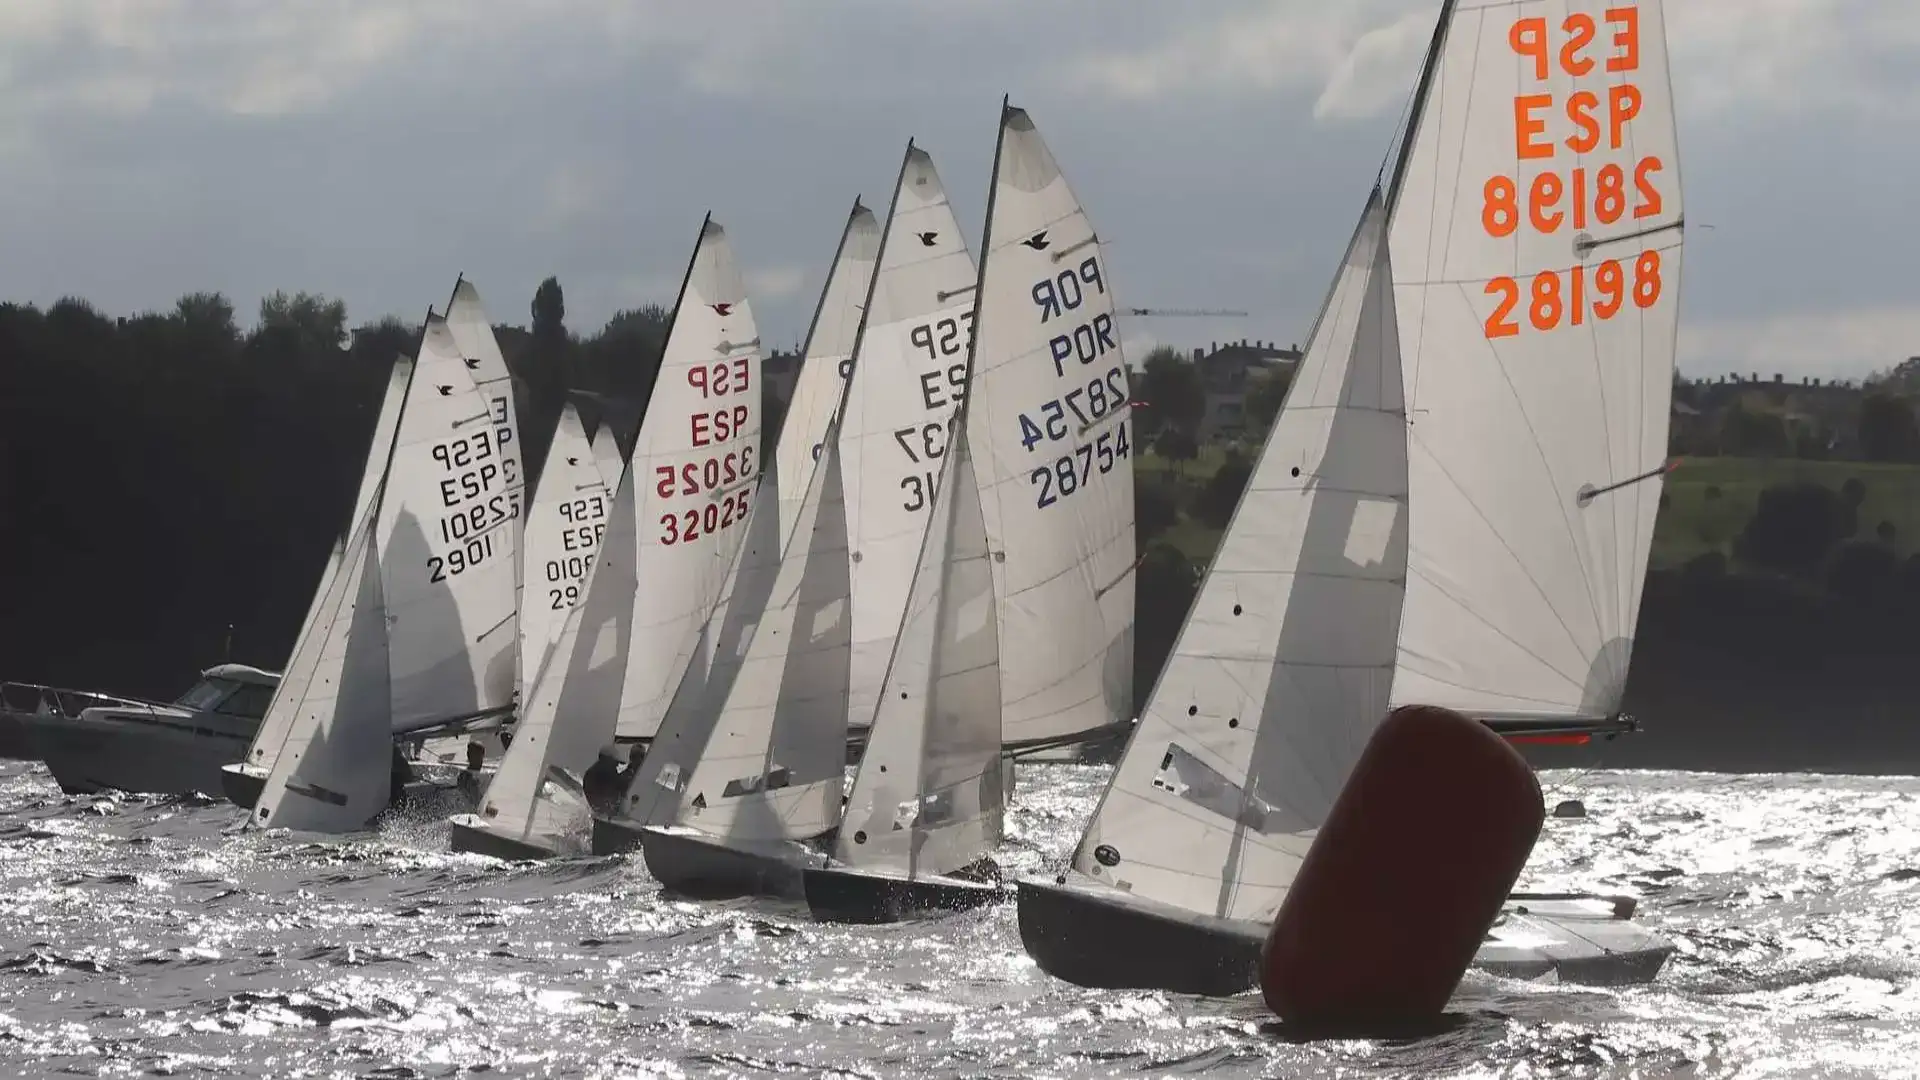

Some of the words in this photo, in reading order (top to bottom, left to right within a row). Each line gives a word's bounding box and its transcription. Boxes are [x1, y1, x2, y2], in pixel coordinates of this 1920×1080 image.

[1514, 85, 1642, 160] ESP
[1484, 249, 1662, 338] 28198
[1050, 313, 1116, 377] POR
[920, 364, 967, 409] ES
[691, 405, 748, 447] ESP
[440, 463, 497, 507] ESP
[1031, 422, 1129, 509] 28754
[660, 489, 750, 546] 32025
[427, 535, 492, 583] 2901
